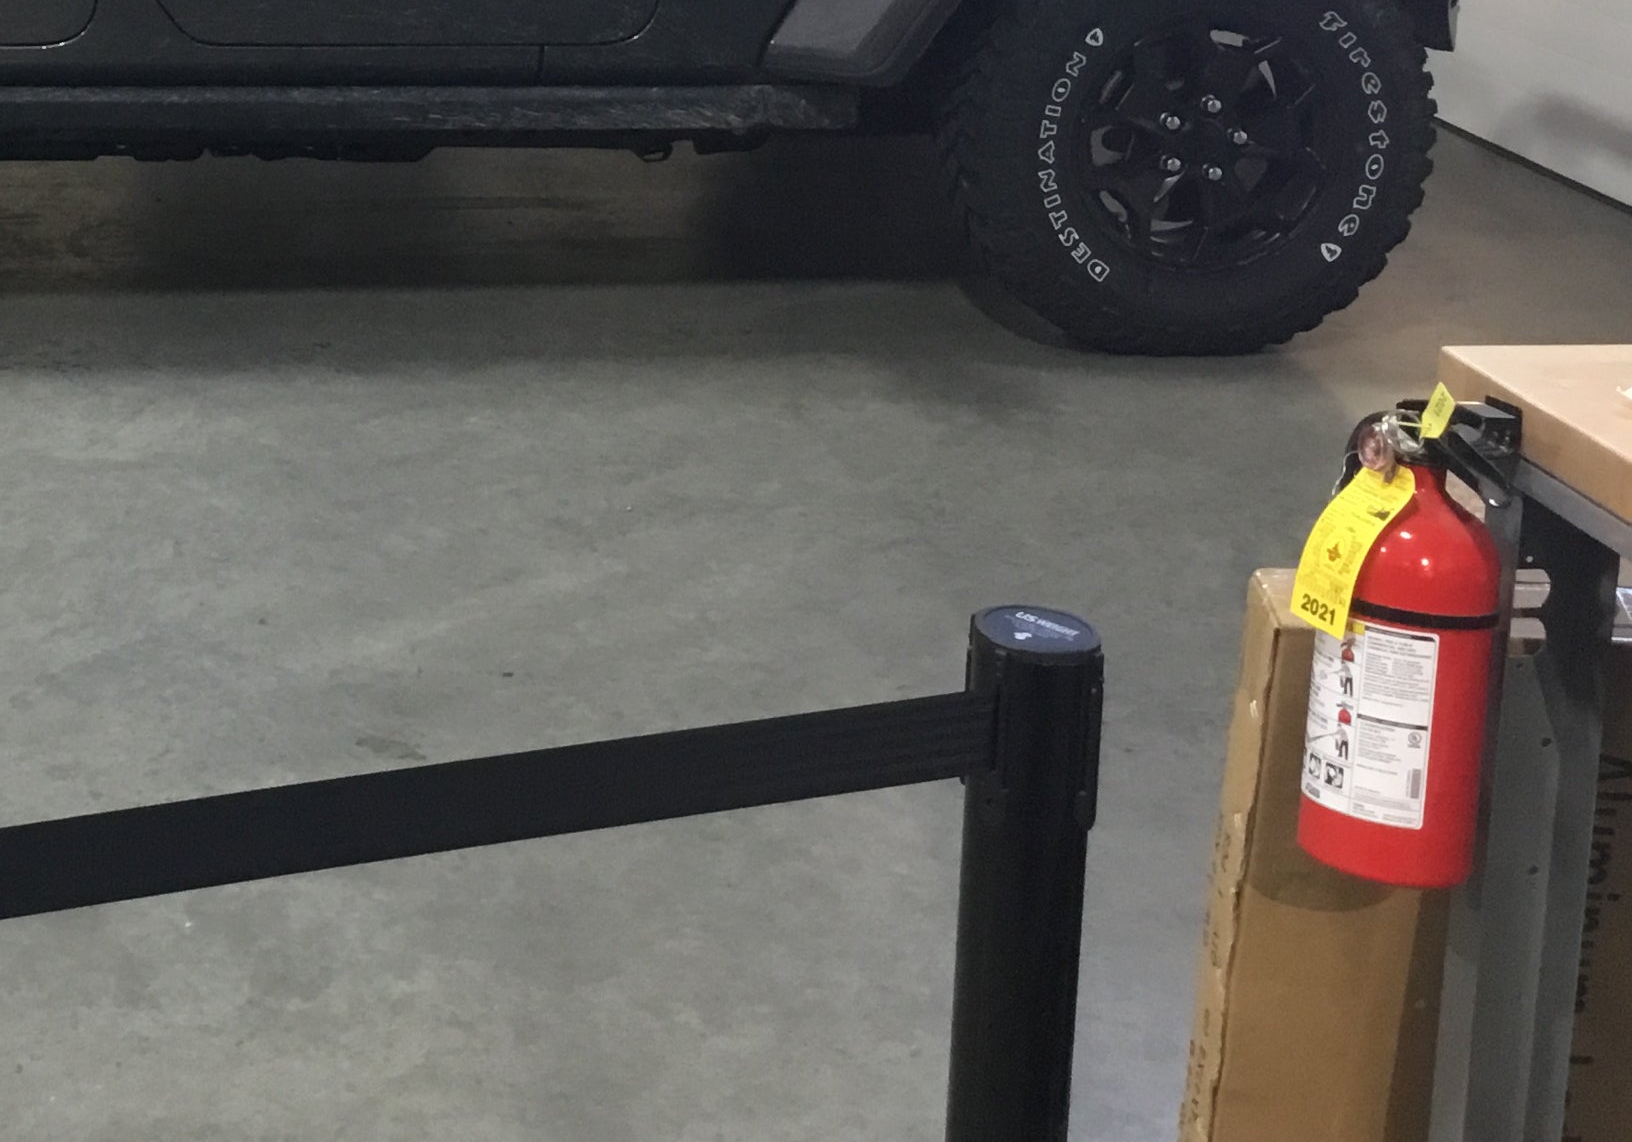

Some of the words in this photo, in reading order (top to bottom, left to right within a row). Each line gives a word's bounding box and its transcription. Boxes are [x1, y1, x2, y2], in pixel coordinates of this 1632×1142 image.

[1037, 50, 1110, 282] DESTINATION
[1319, 10, 1390, 237] Firestone
[1300, 592, 1336, 627] 2021
